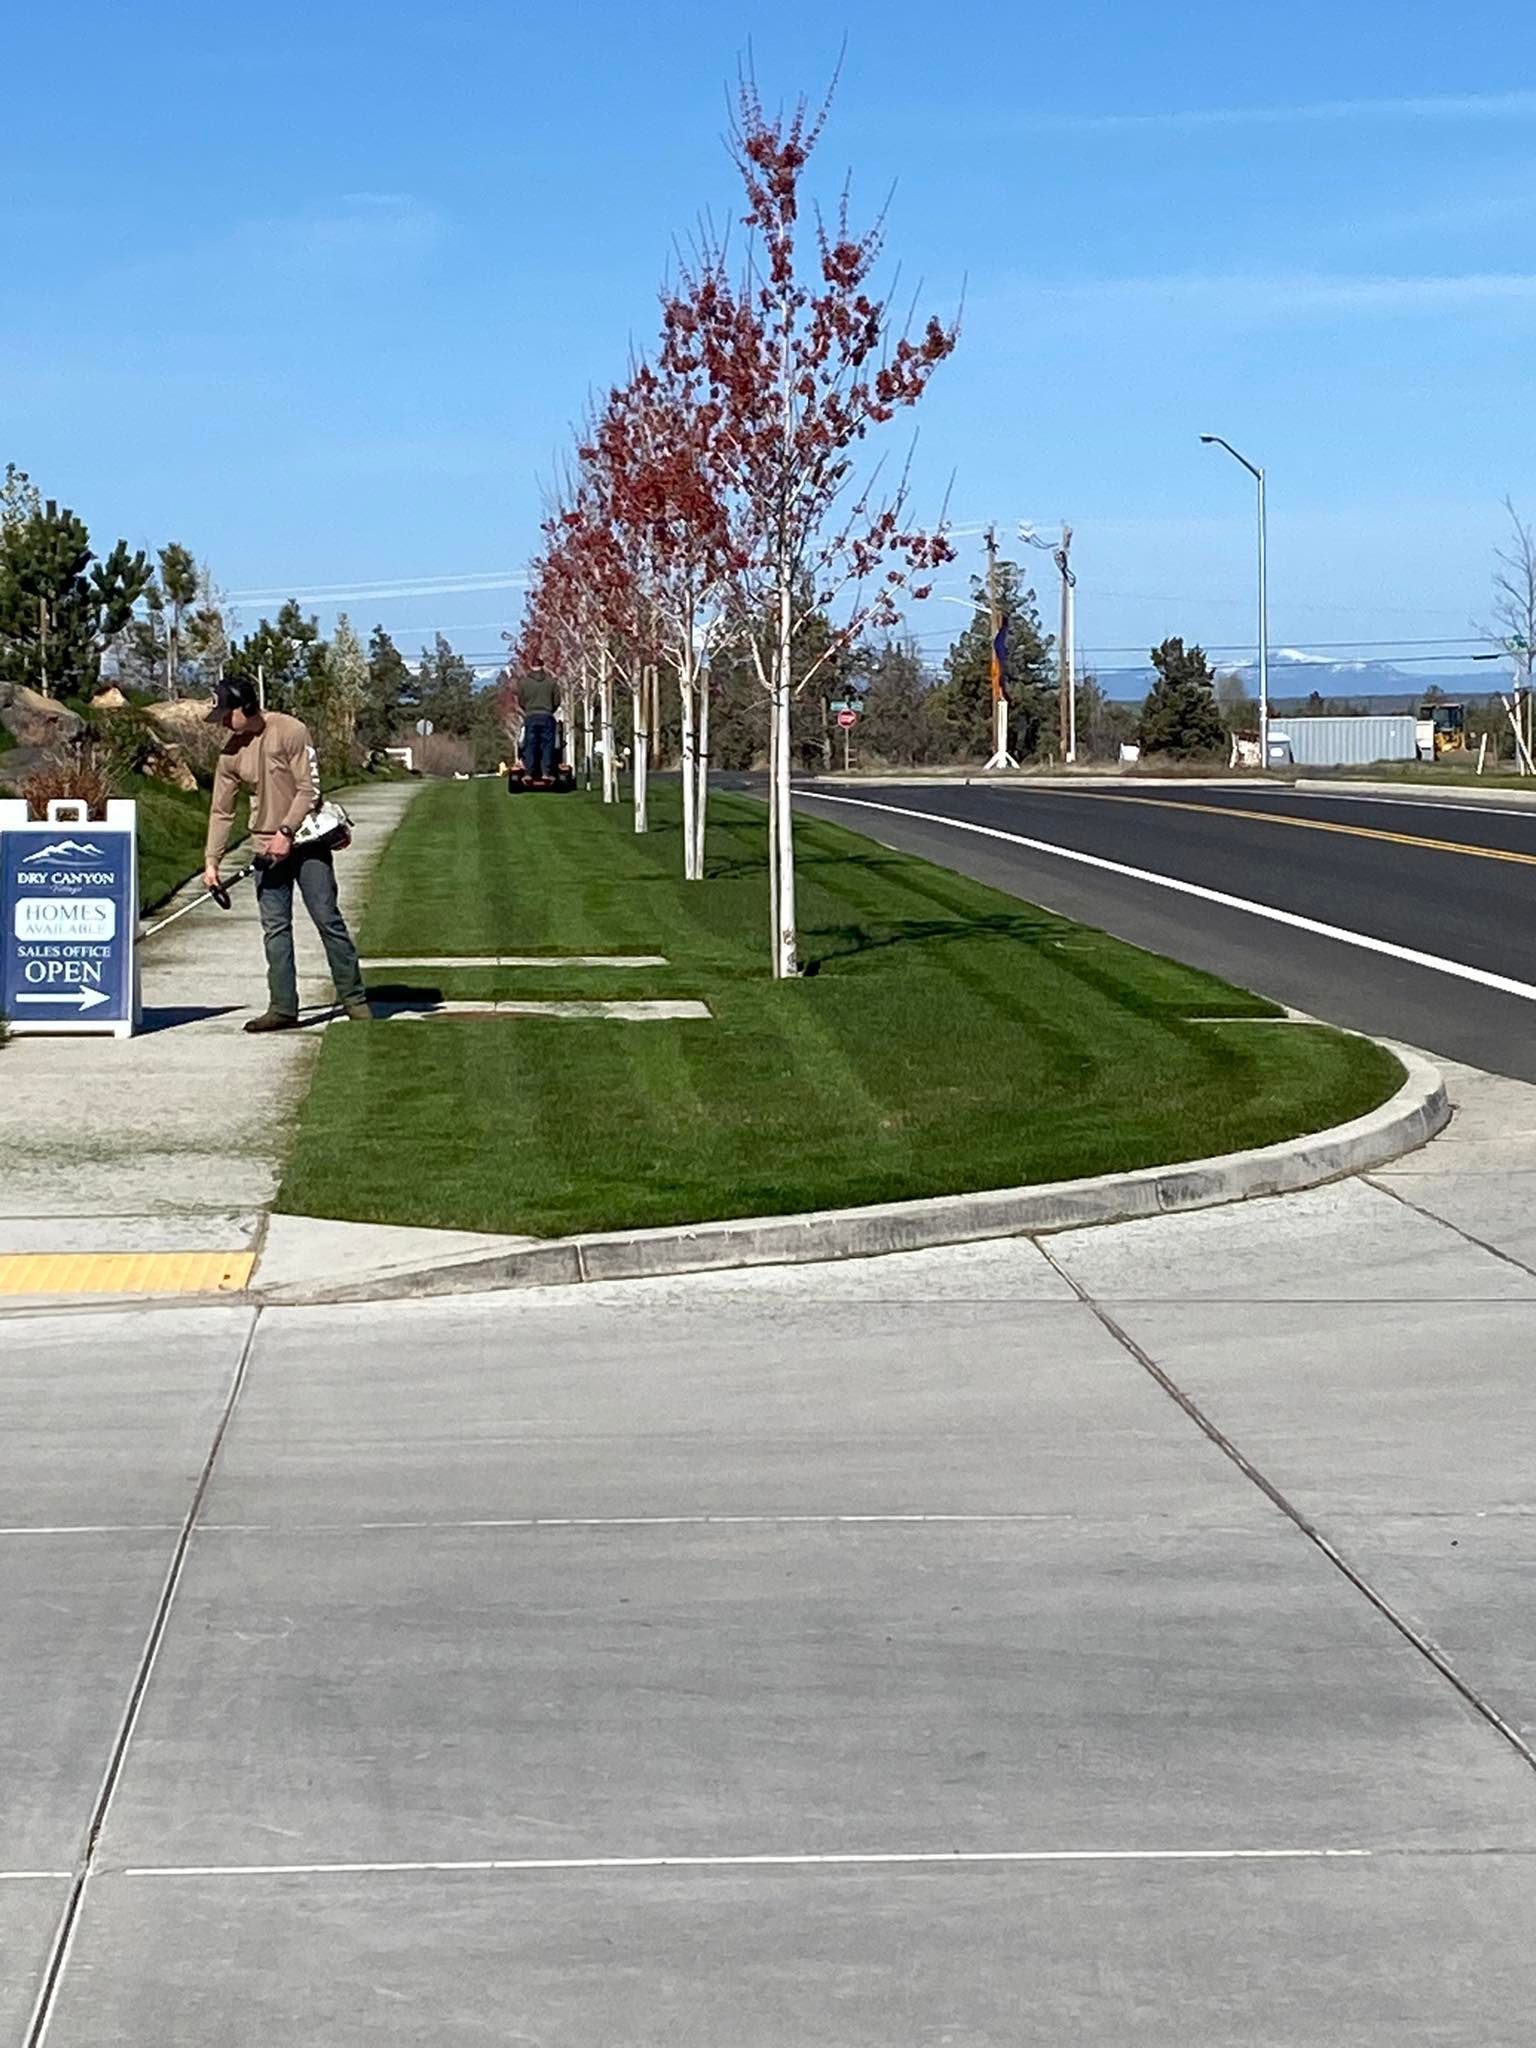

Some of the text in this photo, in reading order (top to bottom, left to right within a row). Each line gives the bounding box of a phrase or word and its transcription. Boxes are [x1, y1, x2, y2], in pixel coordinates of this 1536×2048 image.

[17, 872, 114, 884] DRY CANYON
[25, 904, 107, 920] HOMES
[26, 924, 104, 934] AVAILABLE
[17, 946, 110, 957] SALES OFFICE
[25, 961, 102, 982] OPEN
